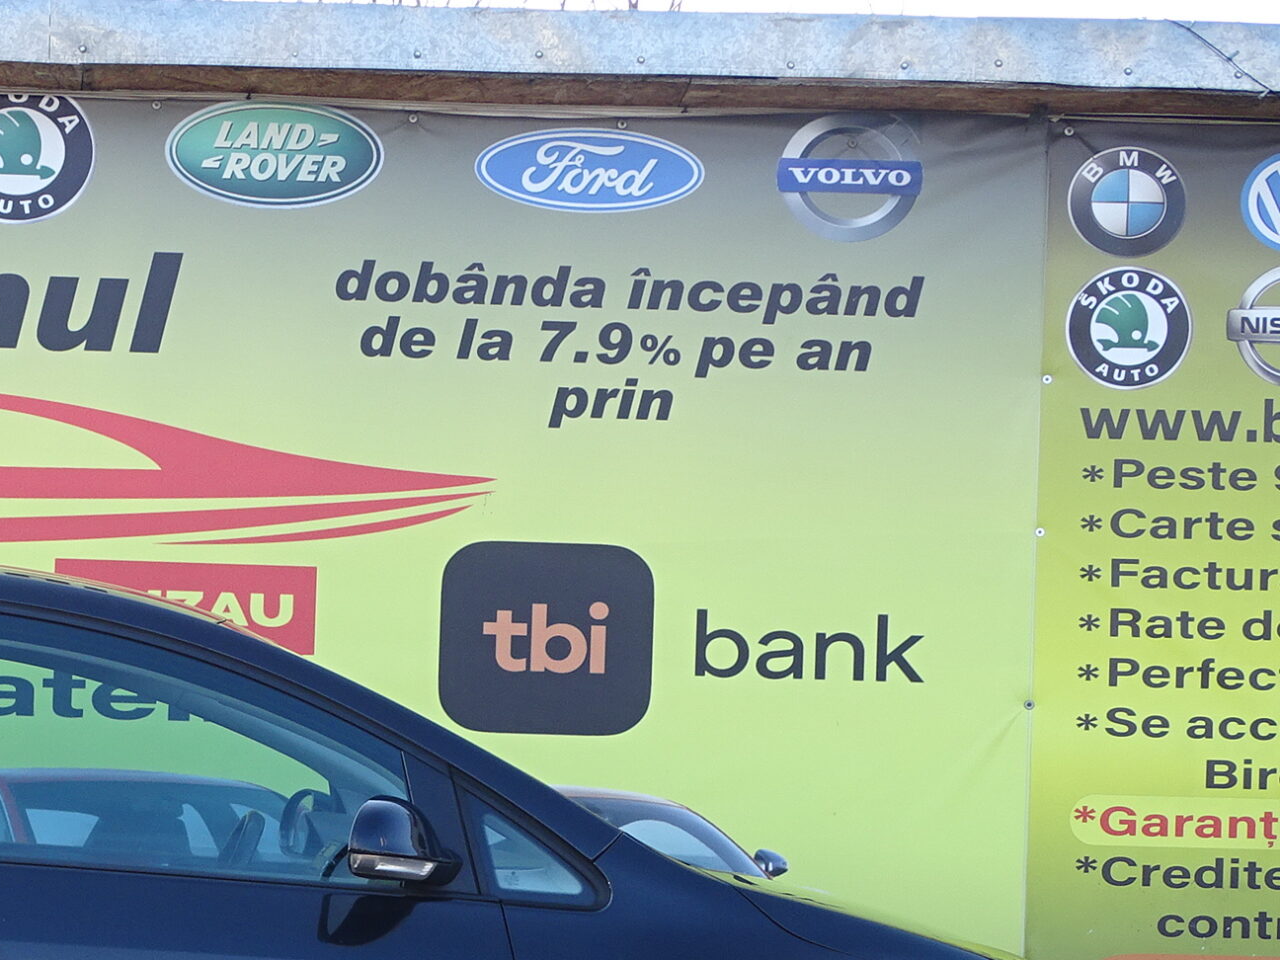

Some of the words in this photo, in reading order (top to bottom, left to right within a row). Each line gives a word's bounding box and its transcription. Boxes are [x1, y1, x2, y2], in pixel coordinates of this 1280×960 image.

[214, 120, 316, 151] LAND
[222, 152, 347, 183] ROVER
[521, 140, 654, 200] Ford
[789, 165, 912, 188] VOLVO
[1081, 151, 1177, 185] BMW
[334, 259, 606, 311] dobânda
[627, 263, 925, 326] începând
[360, 317, 437, 359] de
[456, 318, 513, 362] la
[538, 320, 681, 366] 7.9%
[695, 332, 776, 378] pe
[795, 338, 872, 372] an
[1095, 362, 1160, 382] AUTO
[548, 378, 675, 429] prin
[482, 601, 610, 675] tbi
[694, 608, 925, 683] bank
[1242, 610, 1280, 642] d
[1156, 912, 1280, 940] cont
